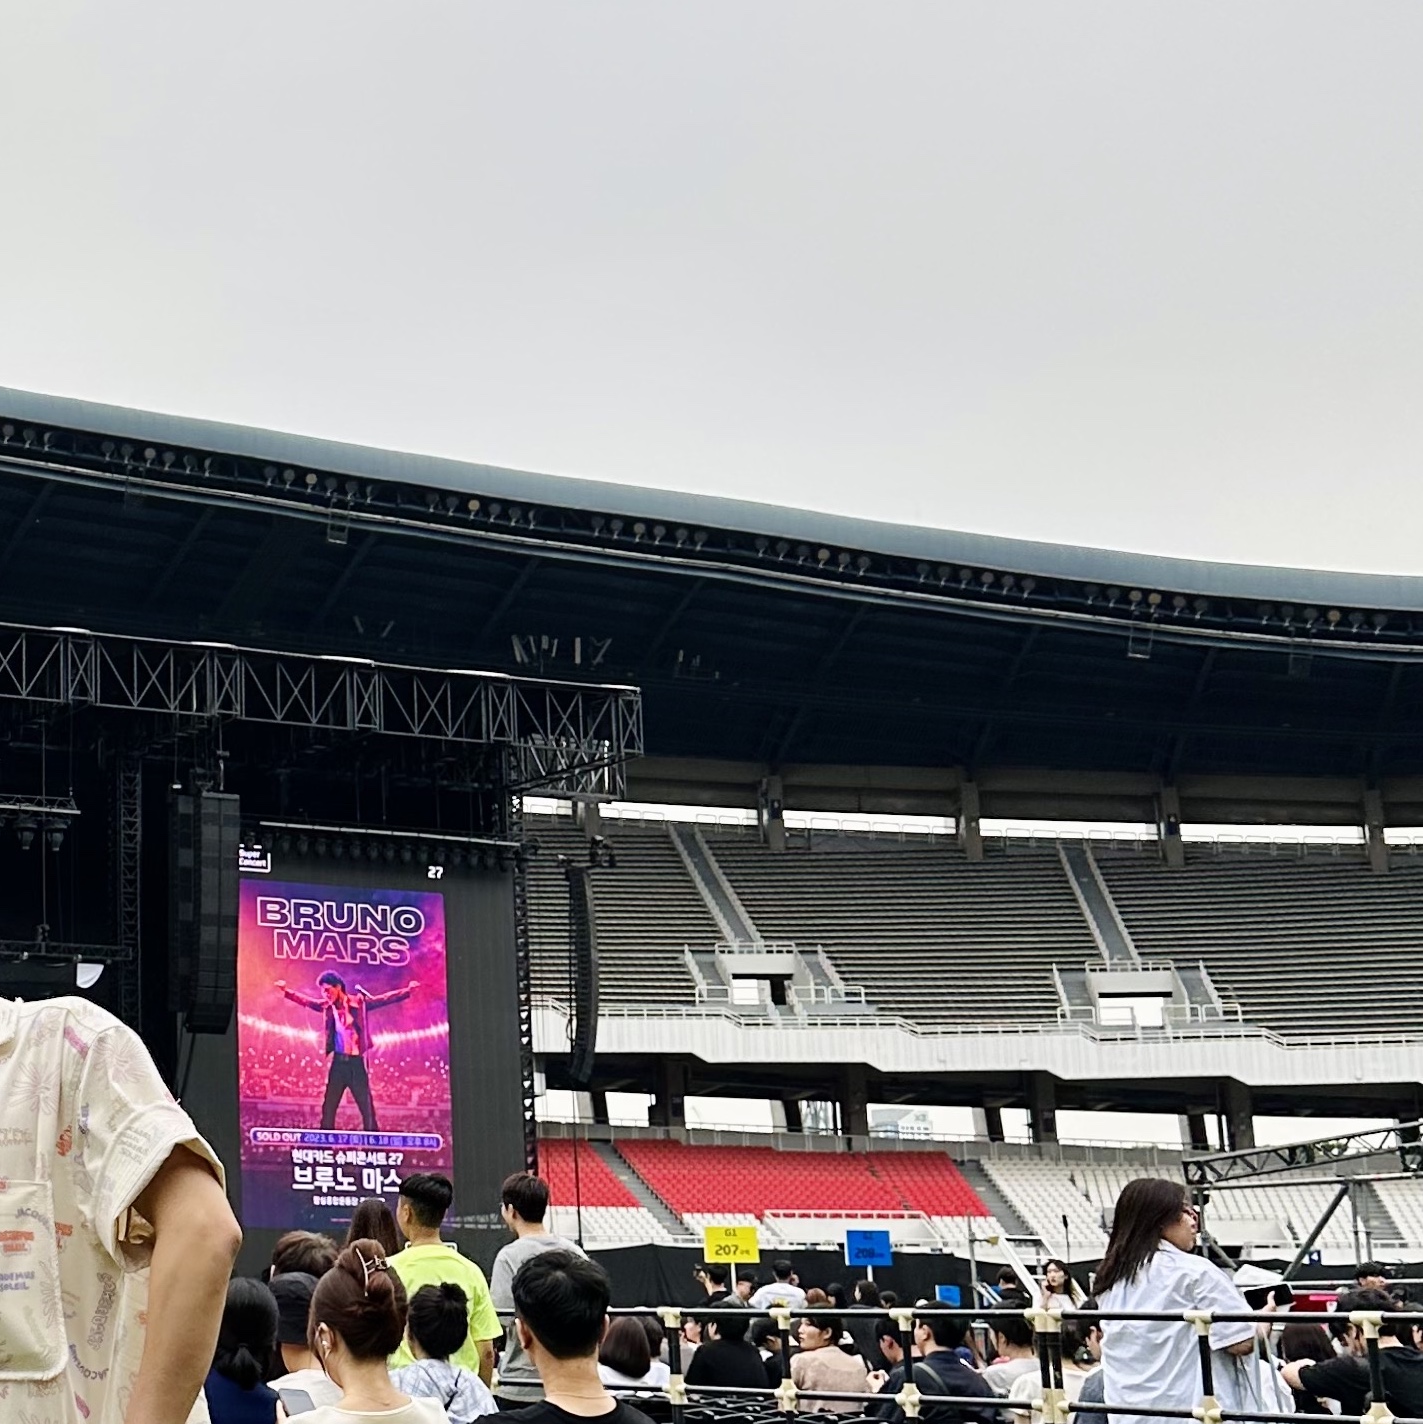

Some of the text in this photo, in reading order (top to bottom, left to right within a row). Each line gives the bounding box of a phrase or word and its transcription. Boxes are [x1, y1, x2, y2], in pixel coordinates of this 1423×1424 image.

[427, 866, 444, 879] 27
[256, 896, 425, 937] BRUNO
[274, 928, 411, 967] MARS
[291, 1166, 403, 1194] 브루노 마스
[714, 1244, 739, 1256] 207
[0, 1282, 30, 1292] SOLEIL
